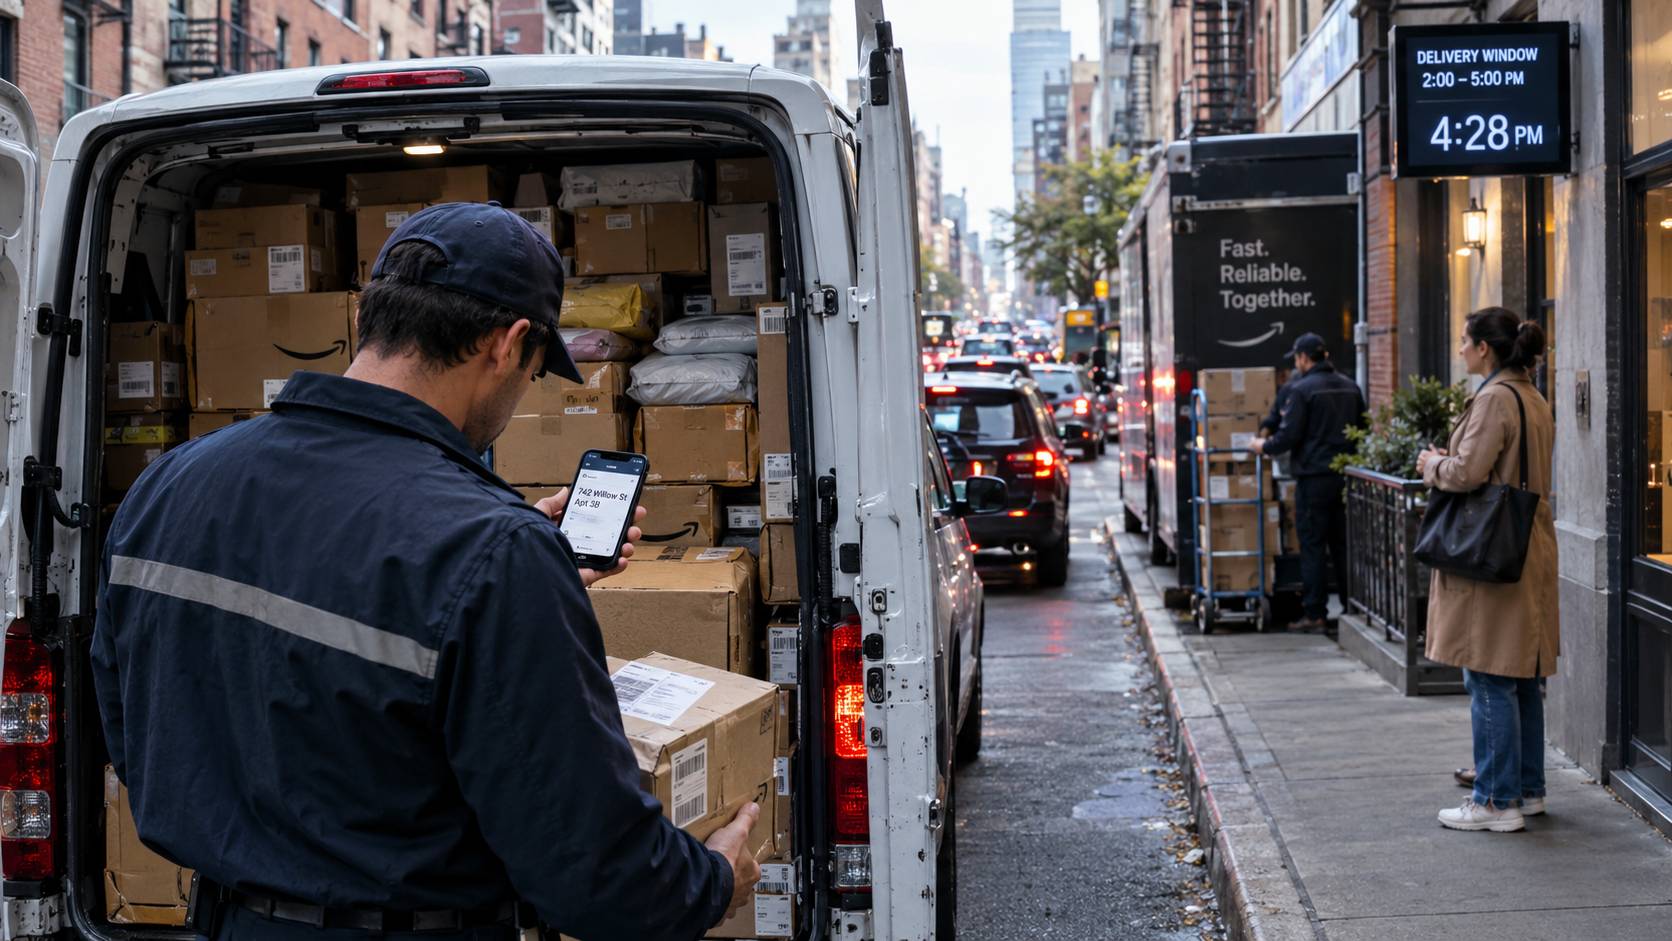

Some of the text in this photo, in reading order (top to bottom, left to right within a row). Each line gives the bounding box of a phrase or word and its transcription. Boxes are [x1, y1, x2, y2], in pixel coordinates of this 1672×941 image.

[1417, 47, 1538, 64] DELIVERY WINDOW
[1422, 71, 1454, 88] 2:00
[1471, 70, 1502, 86] 5:00
[1505, 71, 1524, 85] PM
[1430, 114, 1543, 151] 4:28 PM
[1220, 238, 1269, 258] Fast.
[1220, 262, 1307, 284] Reliable.
[1219, 288, 1316, 313] Together.
[574, 498, 588, 508] Apt
[578, 487, 628, 501] 742 Willow St
